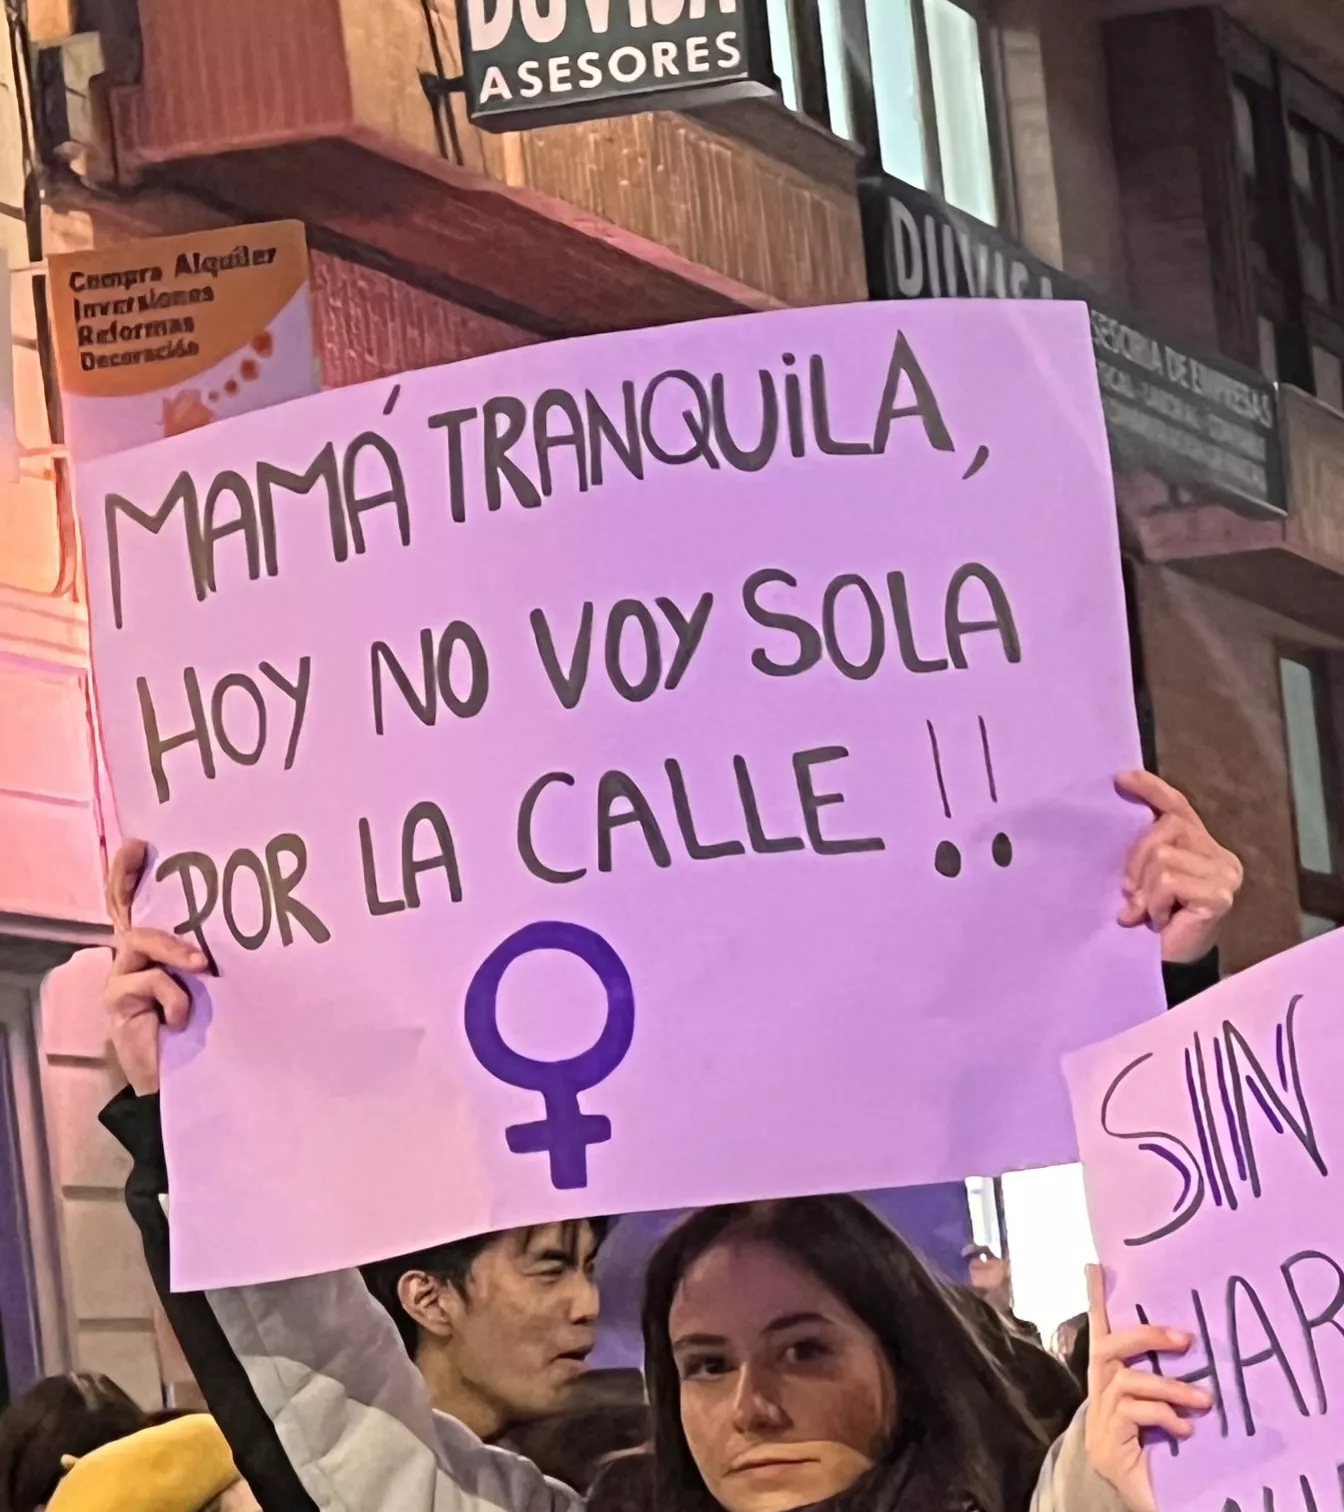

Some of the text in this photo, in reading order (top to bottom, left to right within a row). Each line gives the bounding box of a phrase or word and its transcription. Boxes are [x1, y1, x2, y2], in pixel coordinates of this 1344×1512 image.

[480, 31, 741, 104] ASESORES
[69, 245, 277, 292] Compra Alquiler
[73, 286, 215, 323] Inversiones
[78, 316, 195, 347] Reformas
[80, 340, 200, 372] Decoración
[105, 385, 412, 630] MAMÁ
[136, 561, 1021, 804] HOY NO VOY SOLA
[155, 832, 331, 978] POR
[357, 799, 463, 917] LA
[1100, 992, 1328, 1248] SIN
